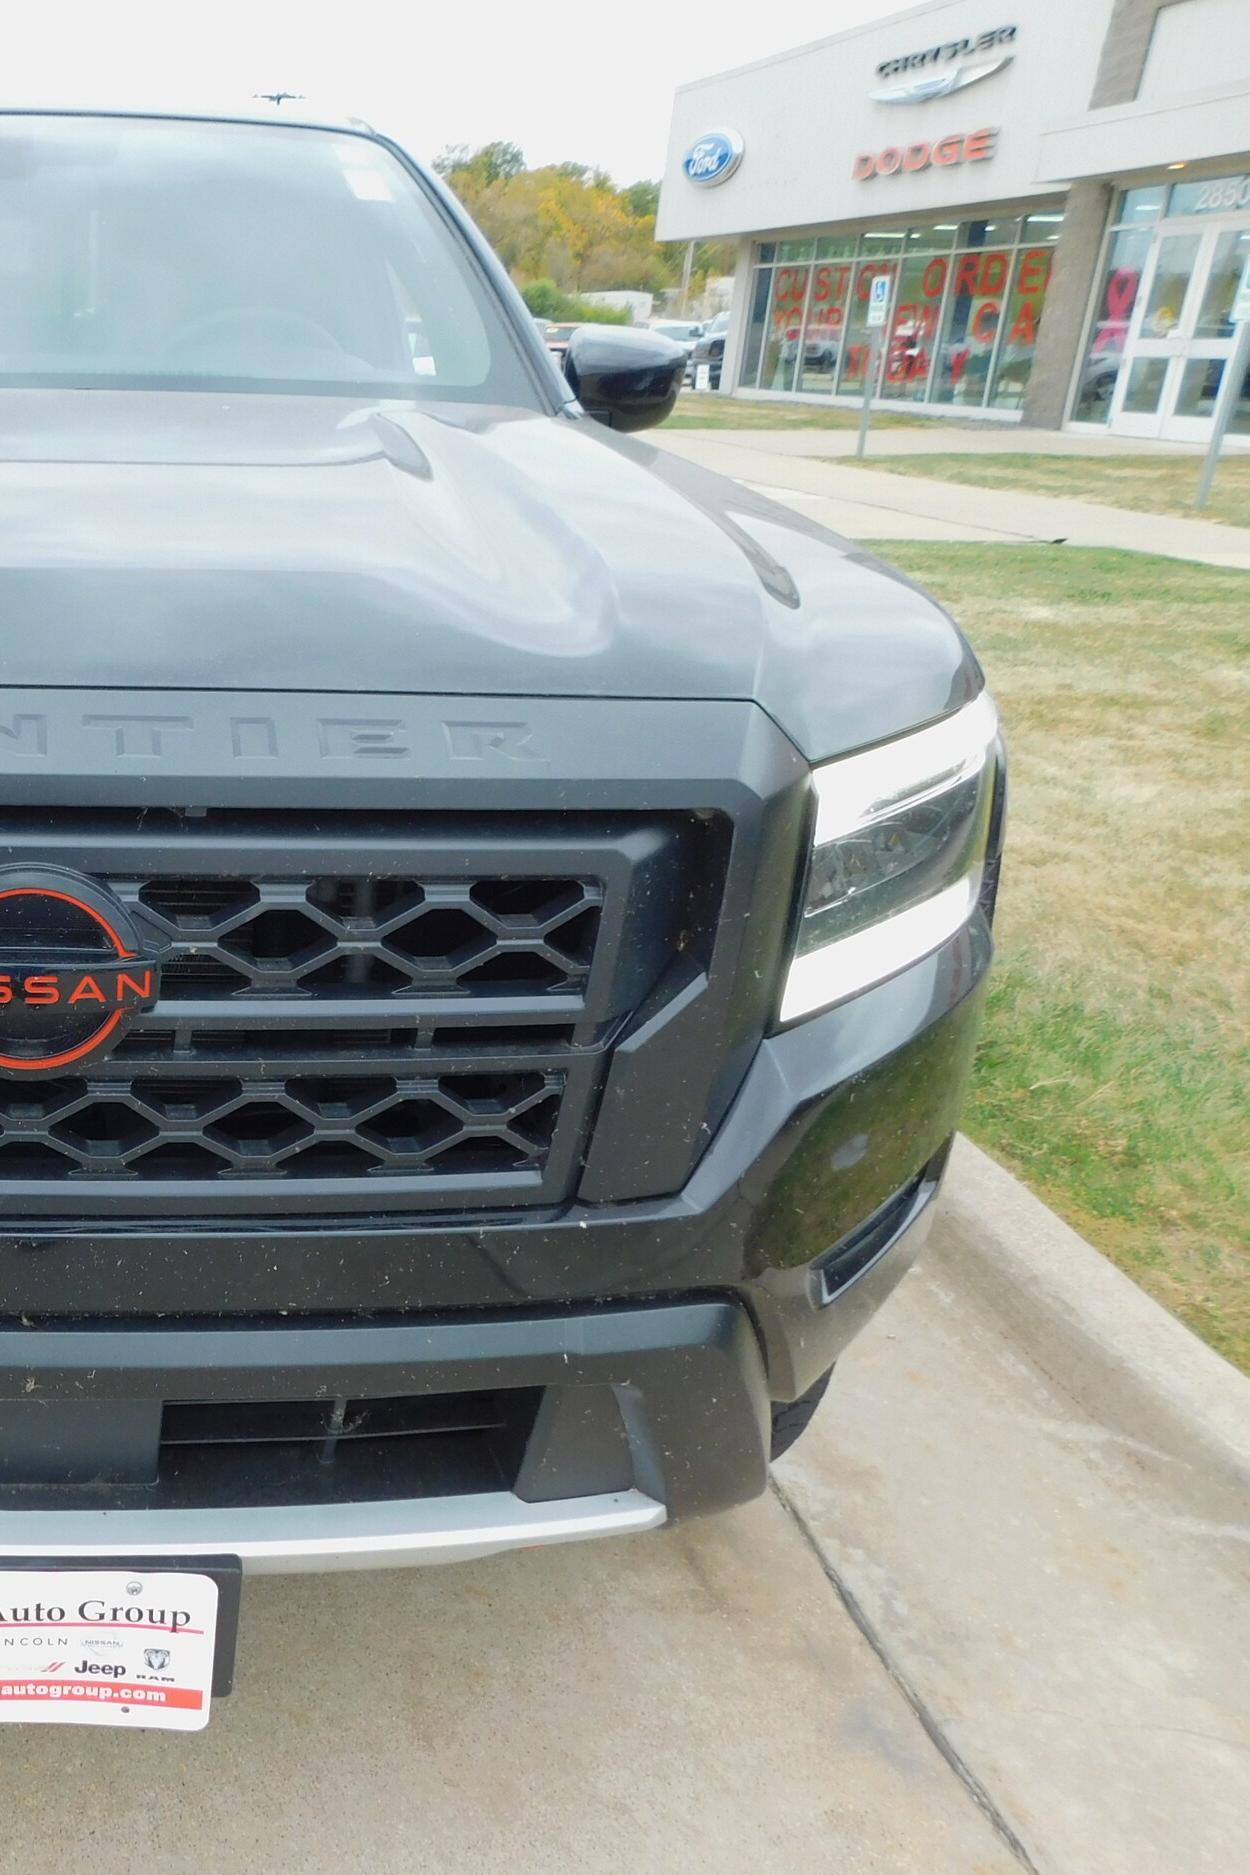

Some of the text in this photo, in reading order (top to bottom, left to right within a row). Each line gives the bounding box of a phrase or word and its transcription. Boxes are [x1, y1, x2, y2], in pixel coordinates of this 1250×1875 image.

[876, 25, 1018, 77] CHRYSLER
[851, 127, 997, 180] DODGE
[776, 263, 897, 301] CUSTO
[922, 250, 1053, 297] ORDE
[78, 1600, 191, 1633] Group
[74, 1660, 127, 1678] Jeep
[136, 1674, 175, 1682] RAM
